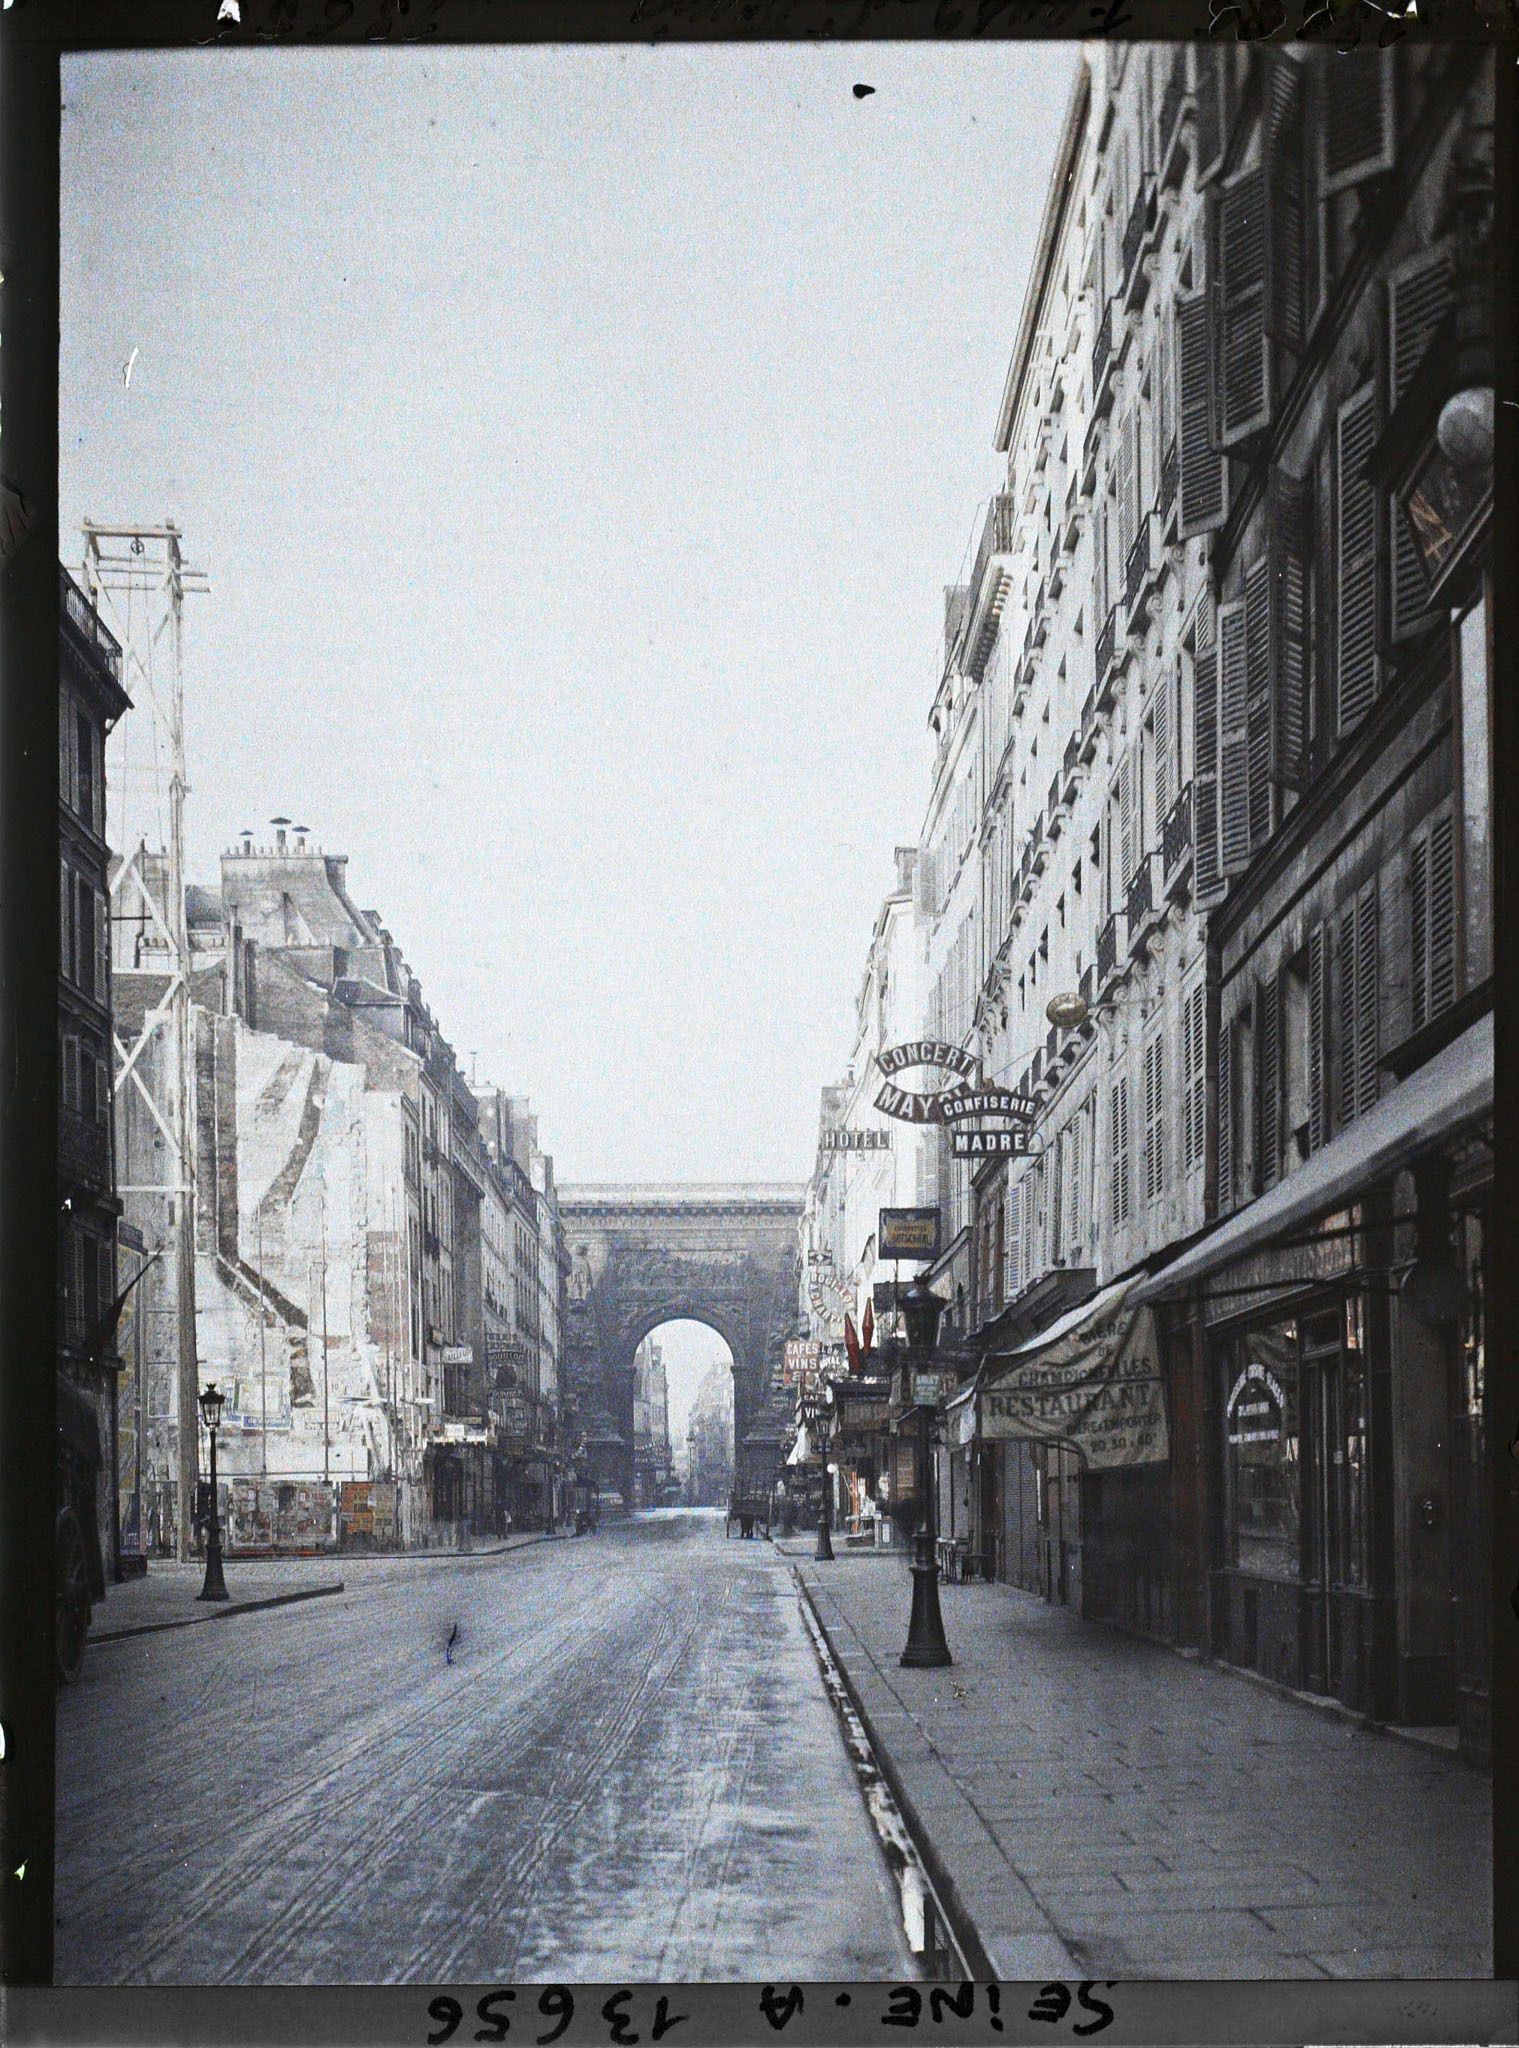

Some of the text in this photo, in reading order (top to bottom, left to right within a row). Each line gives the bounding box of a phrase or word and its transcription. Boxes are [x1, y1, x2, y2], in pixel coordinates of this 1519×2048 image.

[879, 1043, 974, 1073] CONCERT
[877, 1085, 960, 1119] MAY
[943, 1094, 1036, 1116] CONFISERIE
[824, 1131, 884, 1149] HOTEL
[955, 1132, 1026, 1151] MADRE
[788, 1358, 817, 1370] VINS
